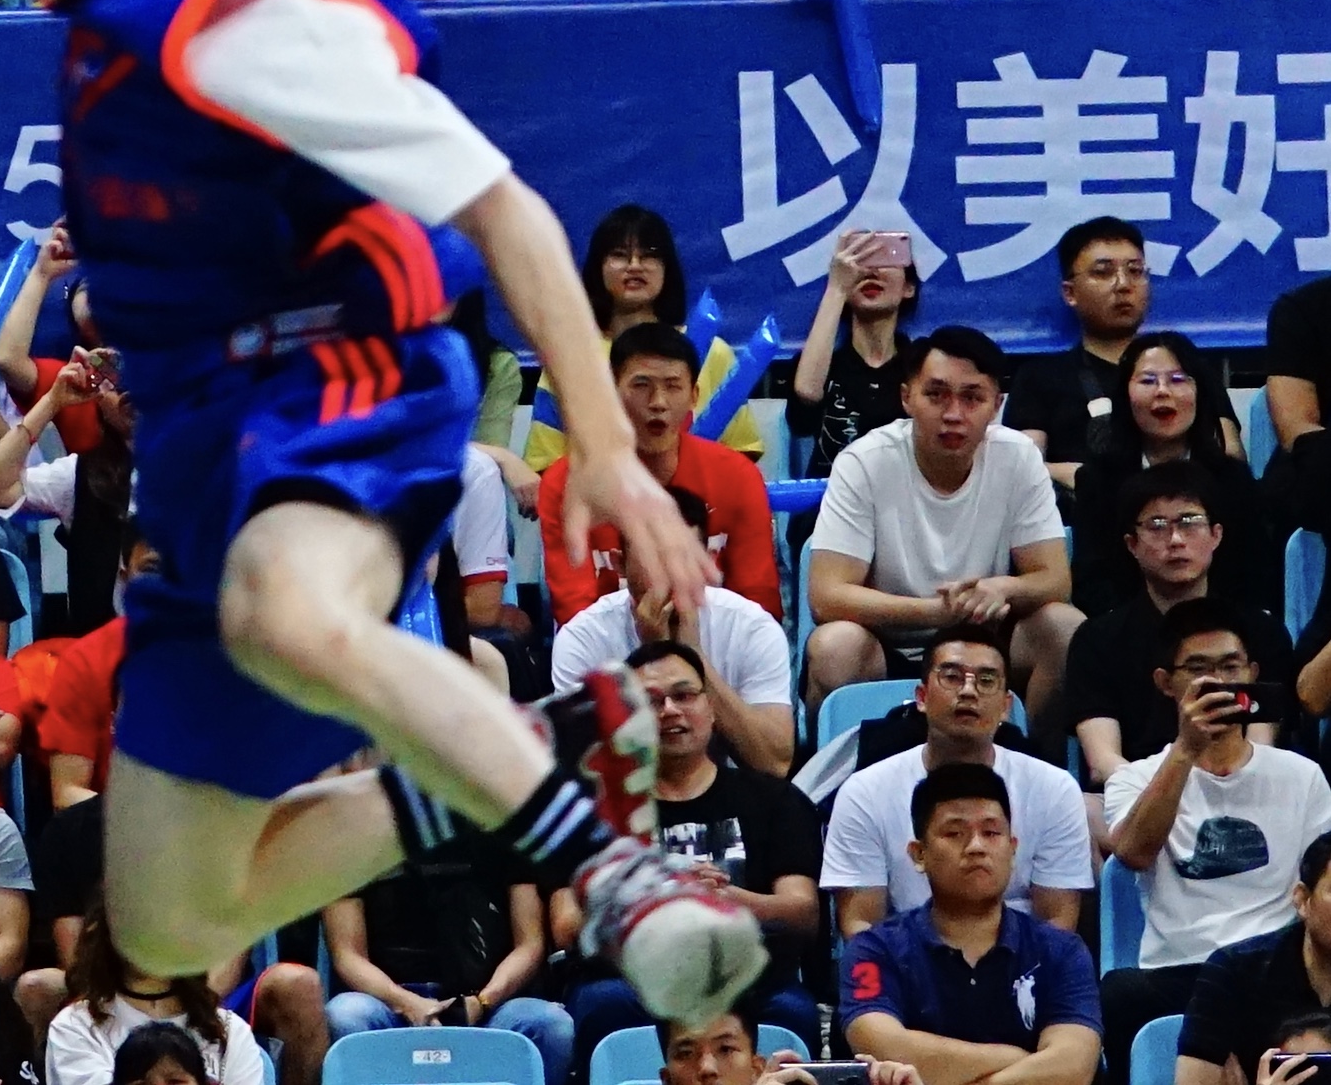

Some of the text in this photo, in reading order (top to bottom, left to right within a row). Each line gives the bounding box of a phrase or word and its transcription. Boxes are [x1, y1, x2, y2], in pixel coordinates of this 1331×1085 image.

[721, 49, 1331, 287] 以美好
[851, 961, 881, 1000] 3
